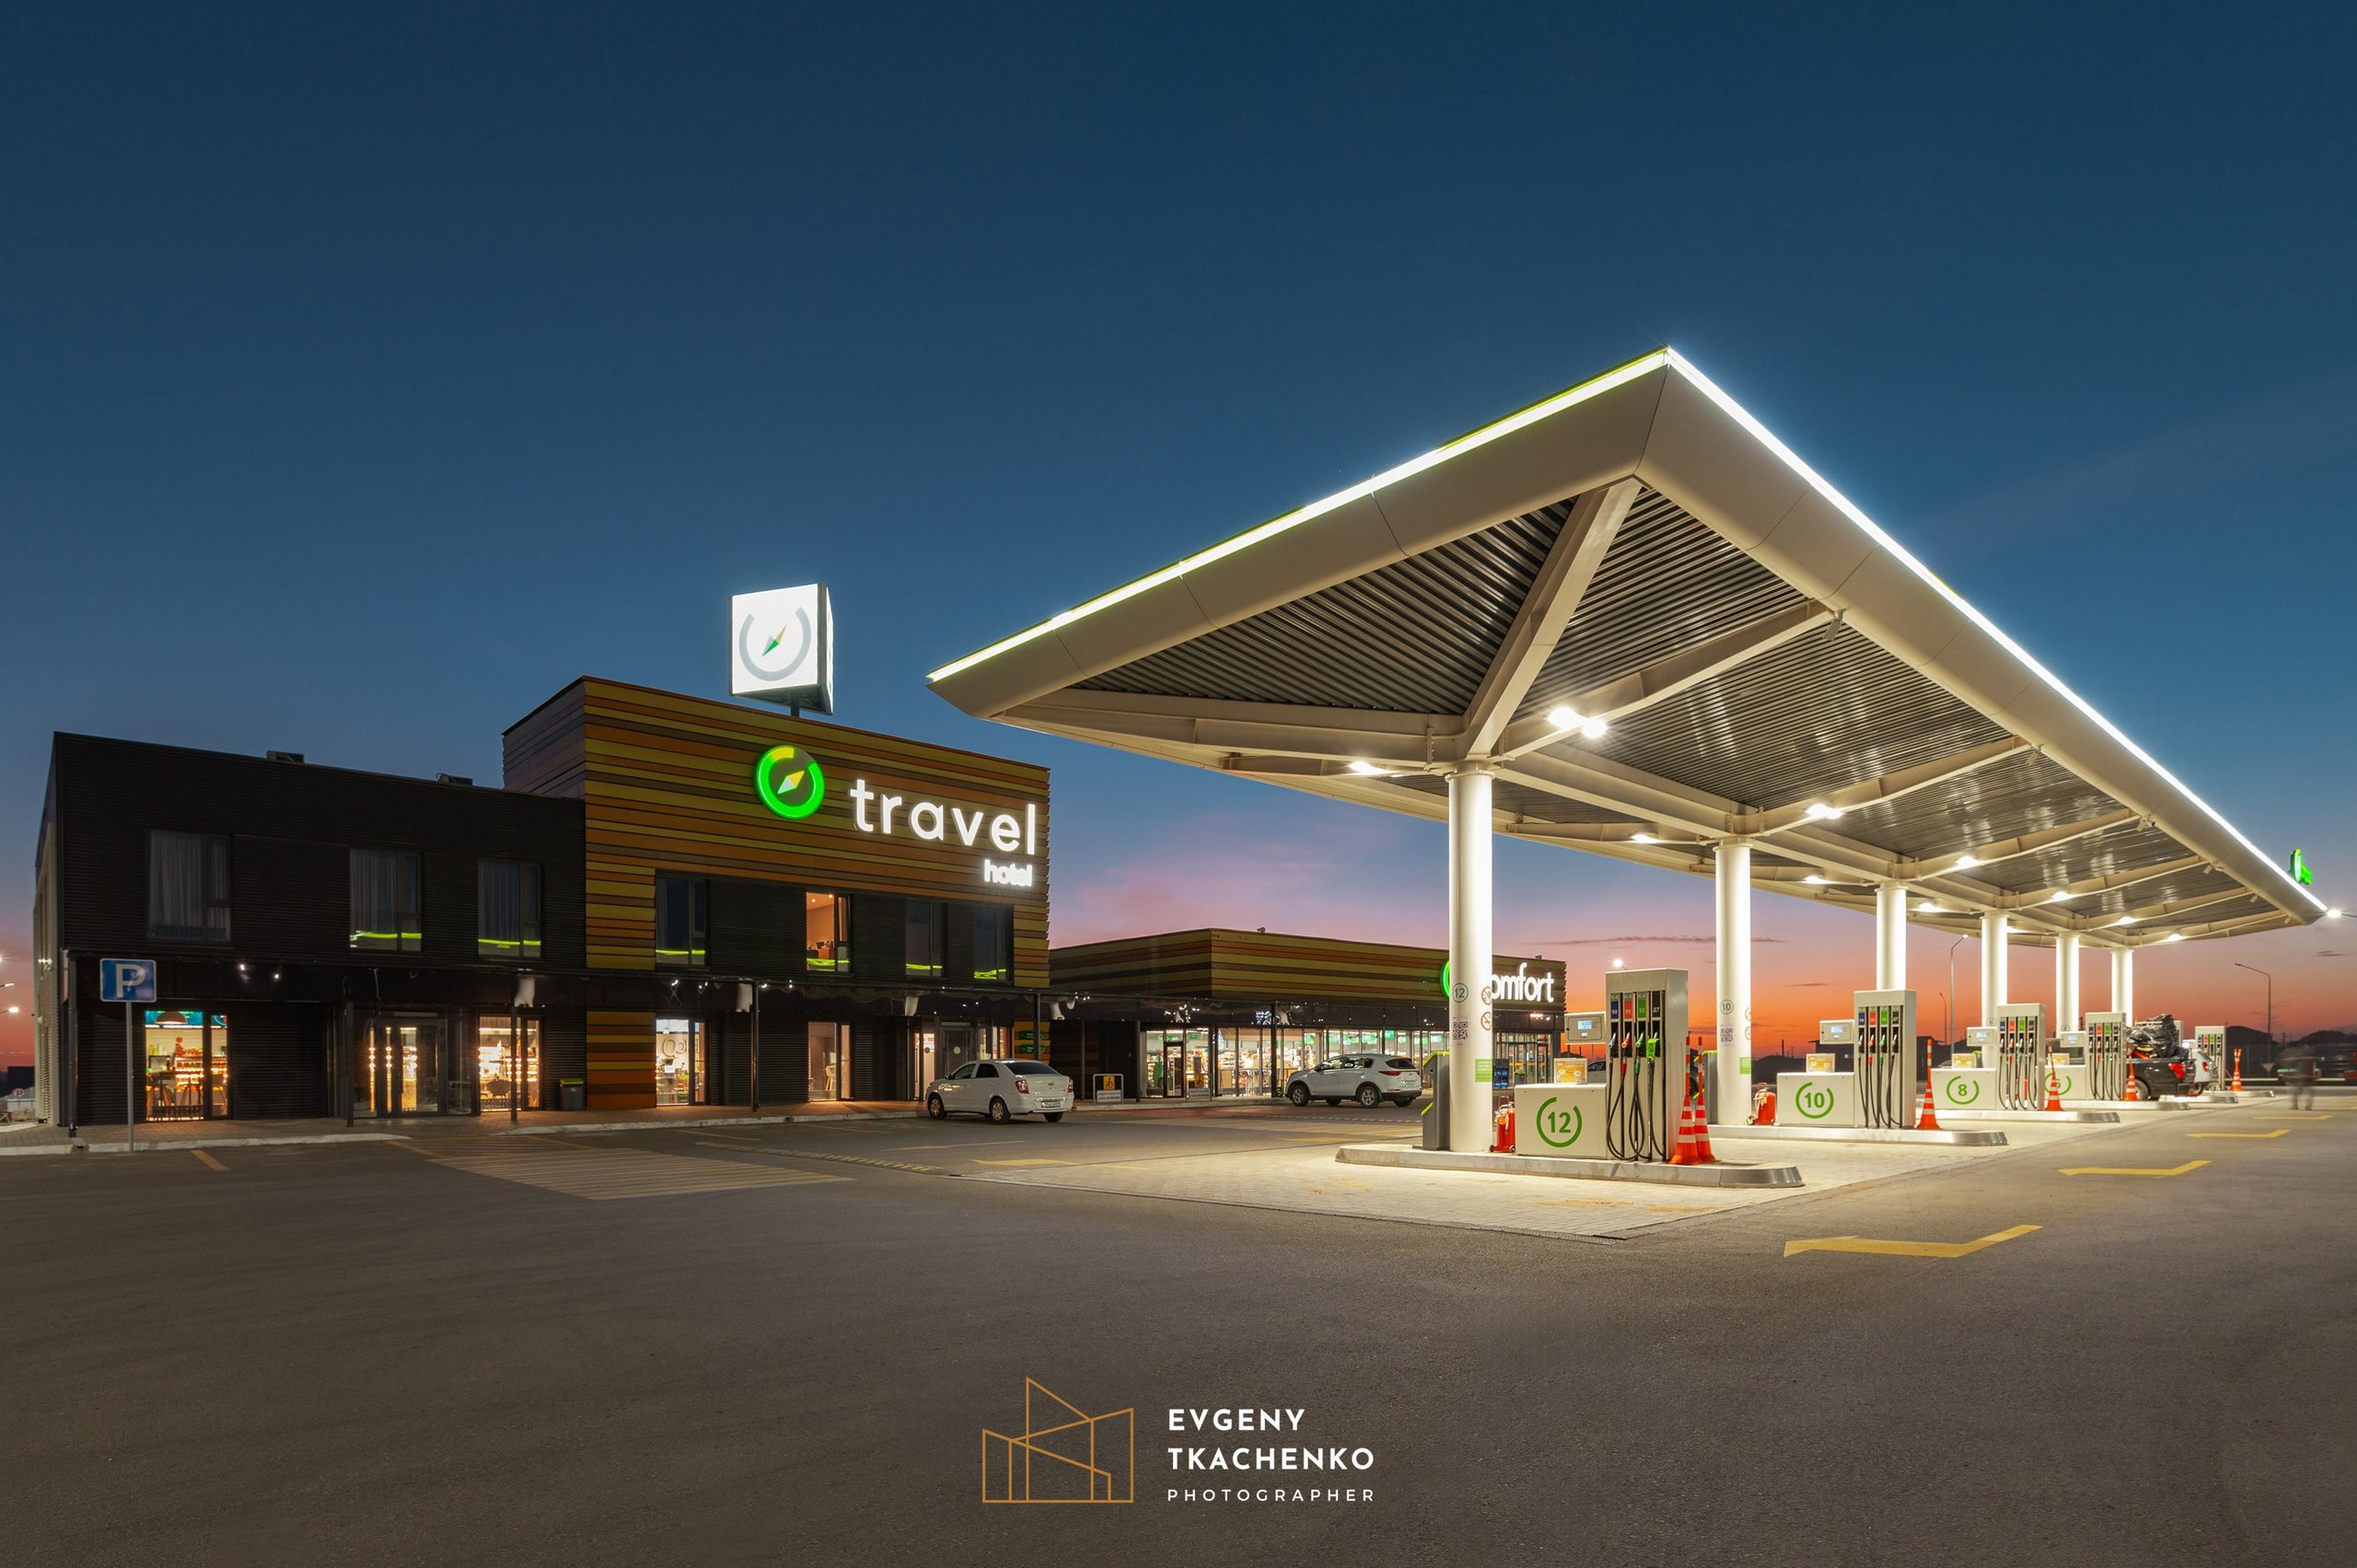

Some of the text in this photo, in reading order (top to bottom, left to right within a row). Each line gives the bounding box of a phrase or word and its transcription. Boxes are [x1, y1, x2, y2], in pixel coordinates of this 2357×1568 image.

[850, 779, 1036, 856] travel
[984, 858, 1033, 888] hotel
[116, 964, 145, 998] P
[1492, 962, 1554, 1003] omfort
[1455, 988, 1465, 998] 12
[1722, 1003, 1731, 1011] 10
[1805, 1092, 1825, 1108] 10
[1958, 1084, 1968, 1096] 8
[1548, 1111, 1571, 1133] 12
